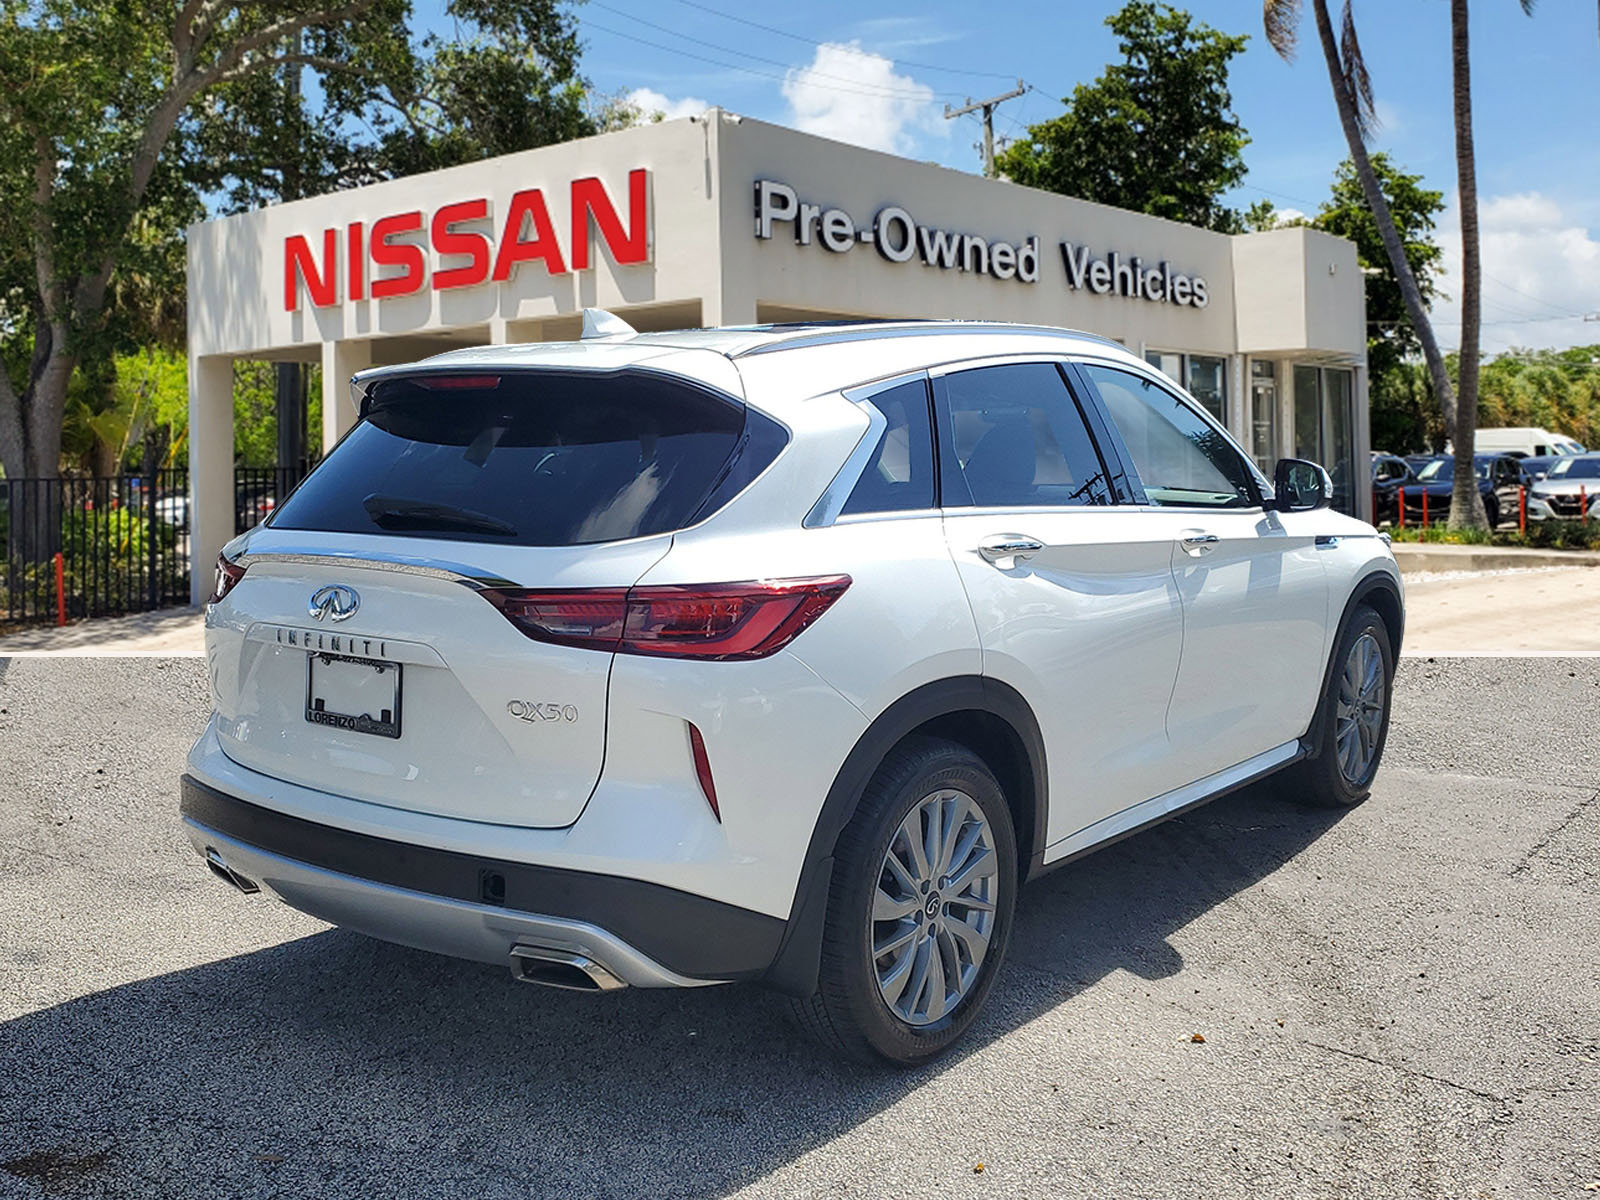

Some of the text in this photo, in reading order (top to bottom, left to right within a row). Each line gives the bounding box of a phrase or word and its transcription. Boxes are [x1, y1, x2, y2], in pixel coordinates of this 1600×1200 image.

[285, 168, 647, 312] NISSAN
[754, 180, 1209, 309] Pre-Owned Vehicles
[277, 627, 386, 658] INFINITI
[308, 710, 356, 731] LORENZO
[506, 699, 579, 725] QX50
